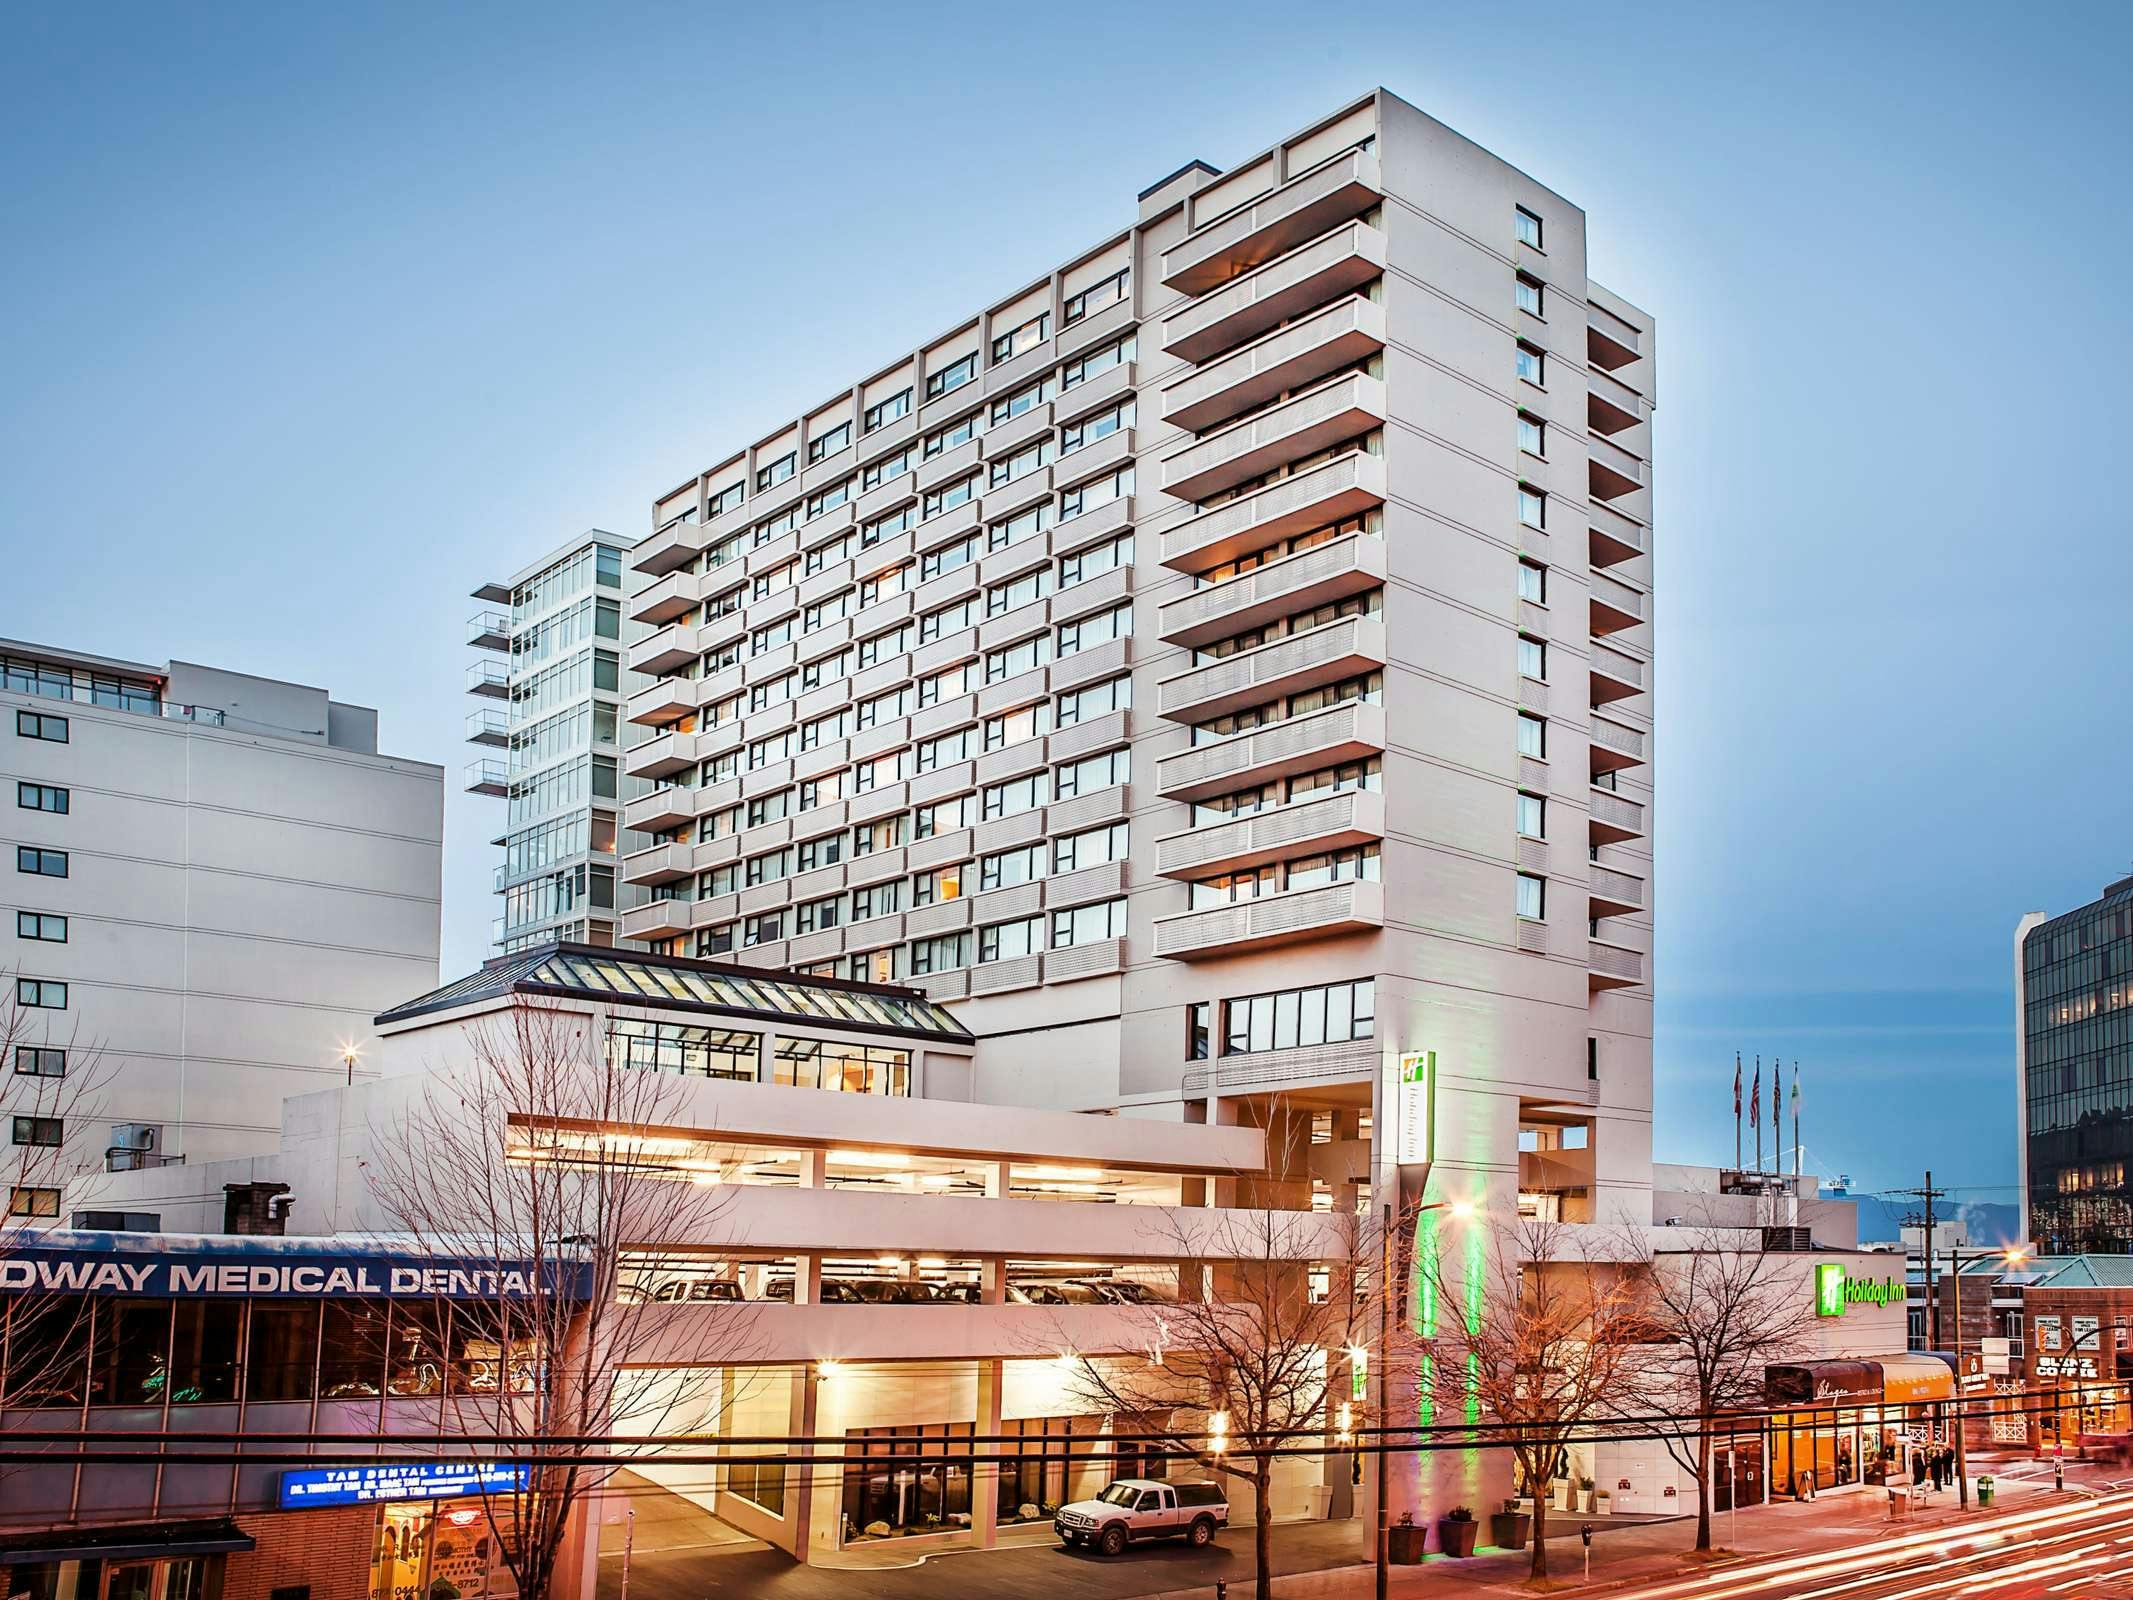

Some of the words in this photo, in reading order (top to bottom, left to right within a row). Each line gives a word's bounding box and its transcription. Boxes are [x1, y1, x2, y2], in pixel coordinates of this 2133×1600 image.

[169, 1265, 382, 1293] MEDICAL
[391, 1267, 551, 1295] DENTAL
[1845, 1276, 1888, 1308] Holiday
[1887, 1276, 1905, 1301] Inn
[2036, 1366, 2098, 1378] COFFEE
[1817, 1379, 1849, 1407] Stages
[327, 1470, 359, 1481] TAM
[367, 1467, 428, 1479] DENTAL
[435, 1463, 495, 1475] CENTRE
